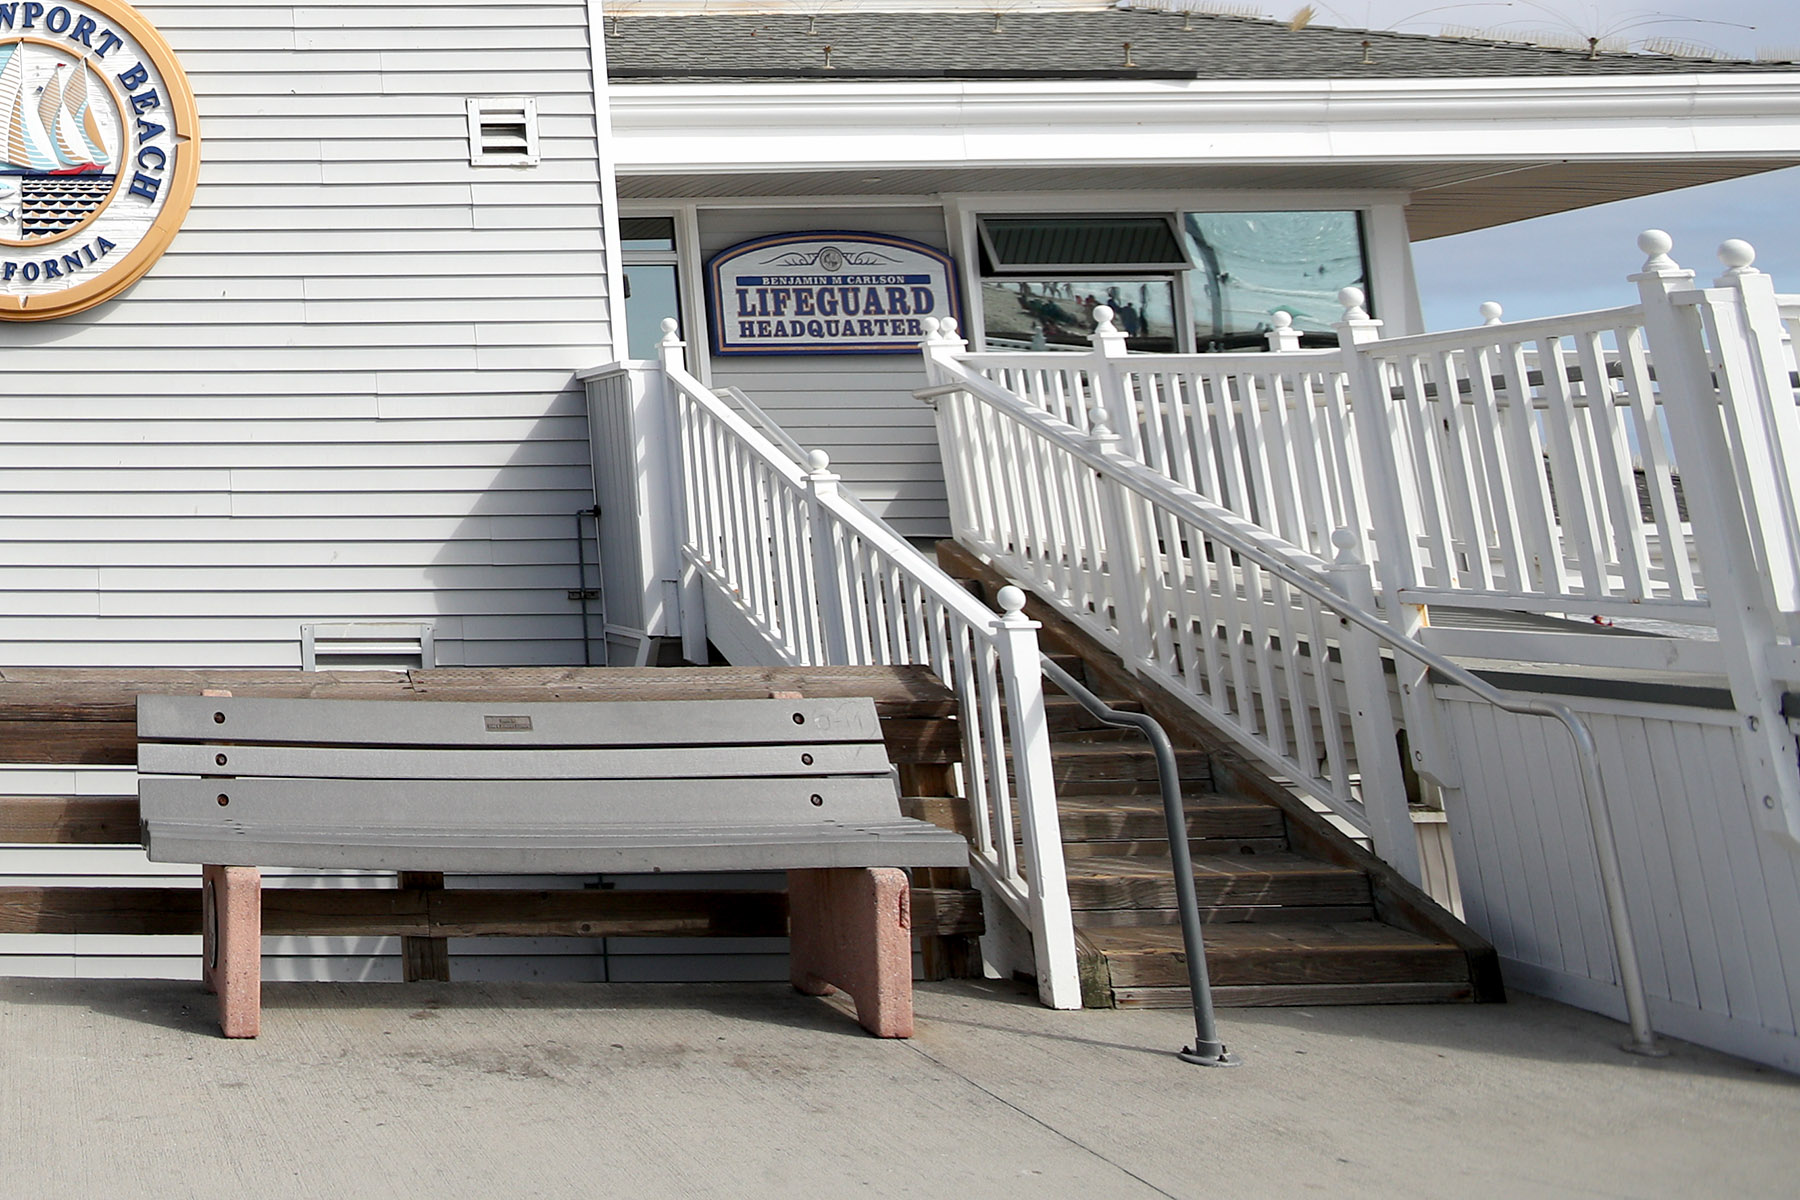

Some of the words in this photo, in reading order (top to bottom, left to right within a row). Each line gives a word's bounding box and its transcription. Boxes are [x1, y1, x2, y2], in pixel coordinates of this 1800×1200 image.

[118, 61, 167, 204] BEACH
[762, 276, 828, 286] BENJAMIN
[831, 276, 843, 285] M
[846, 275, 906, 285] CARLSON
[735, 286, 935, 318] LIFEGUARD
[737, 318, 928, 339] HEADQUARTER
